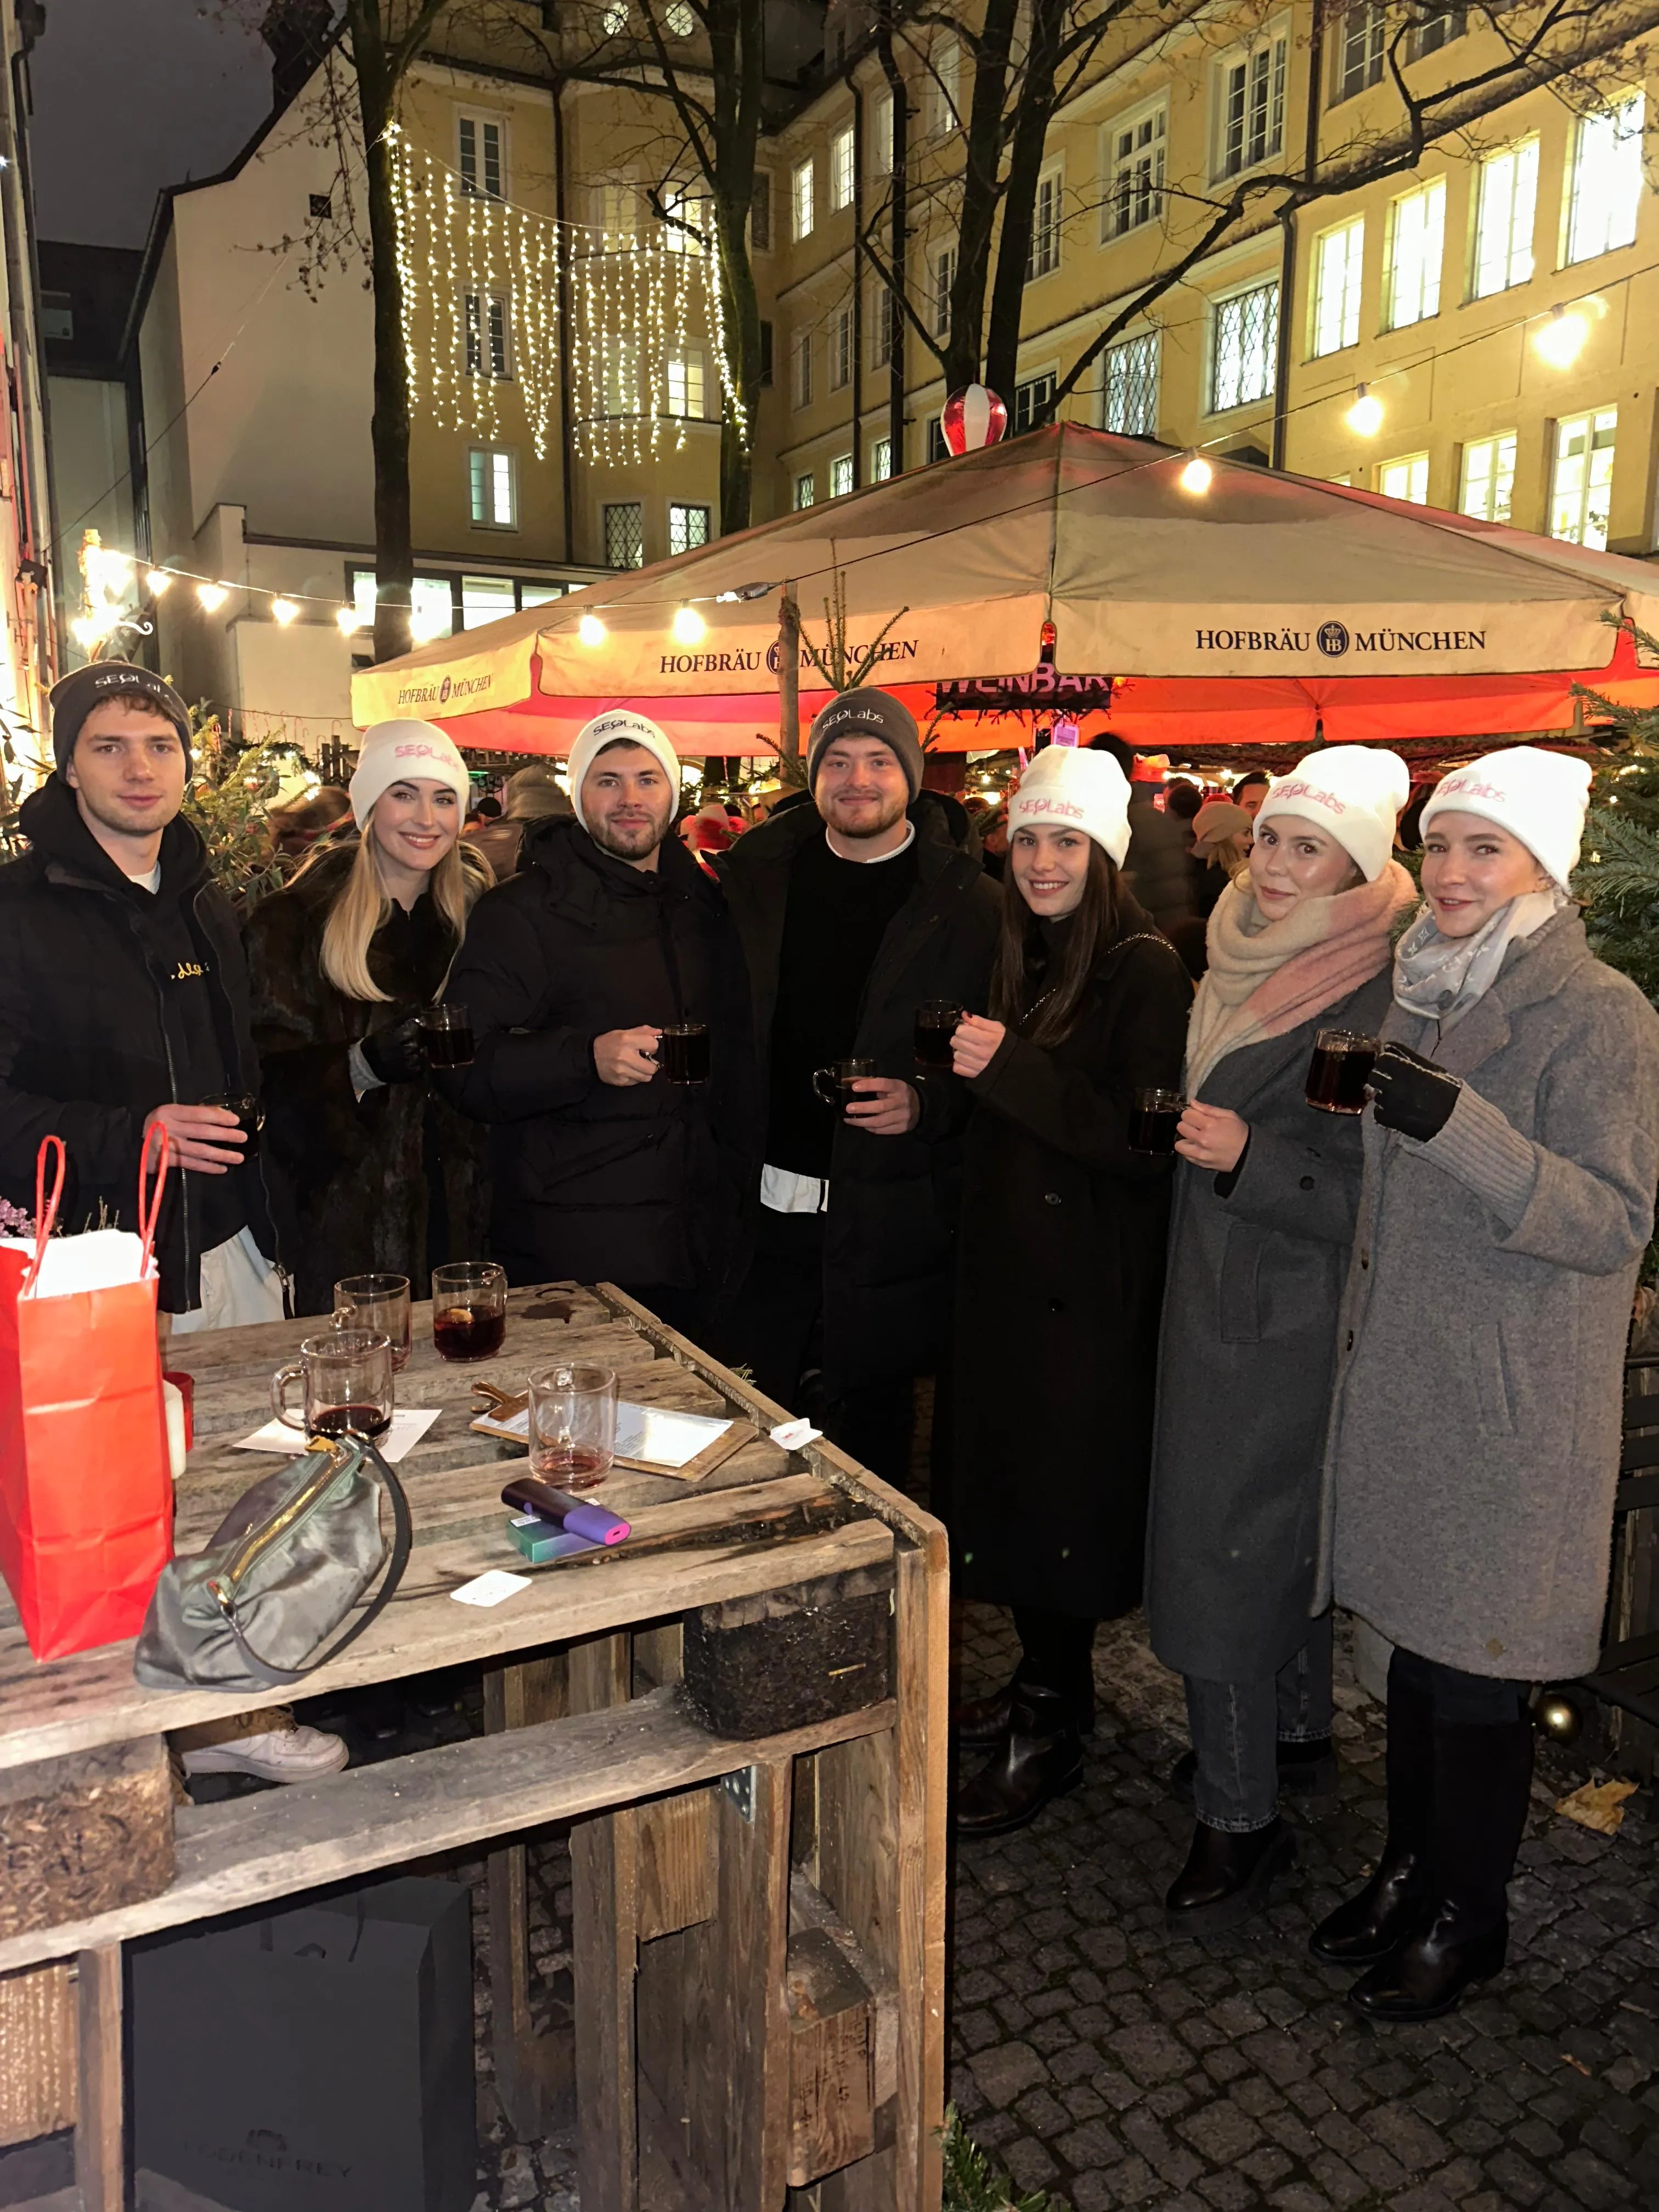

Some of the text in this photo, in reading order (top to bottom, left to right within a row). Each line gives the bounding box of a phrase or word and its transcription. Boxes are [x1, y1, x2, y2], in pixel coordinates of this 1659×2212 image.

[1195, 628, 1311, 651] HOFBRÄU
[1355, 628, 1486, 651] MÜNCHEN
[659, 648, 761, 673] HOFBRÄU
[398, 684, 440, 704] HOFBRÄU
[1436, 778, 1507, 803] EOLabs
